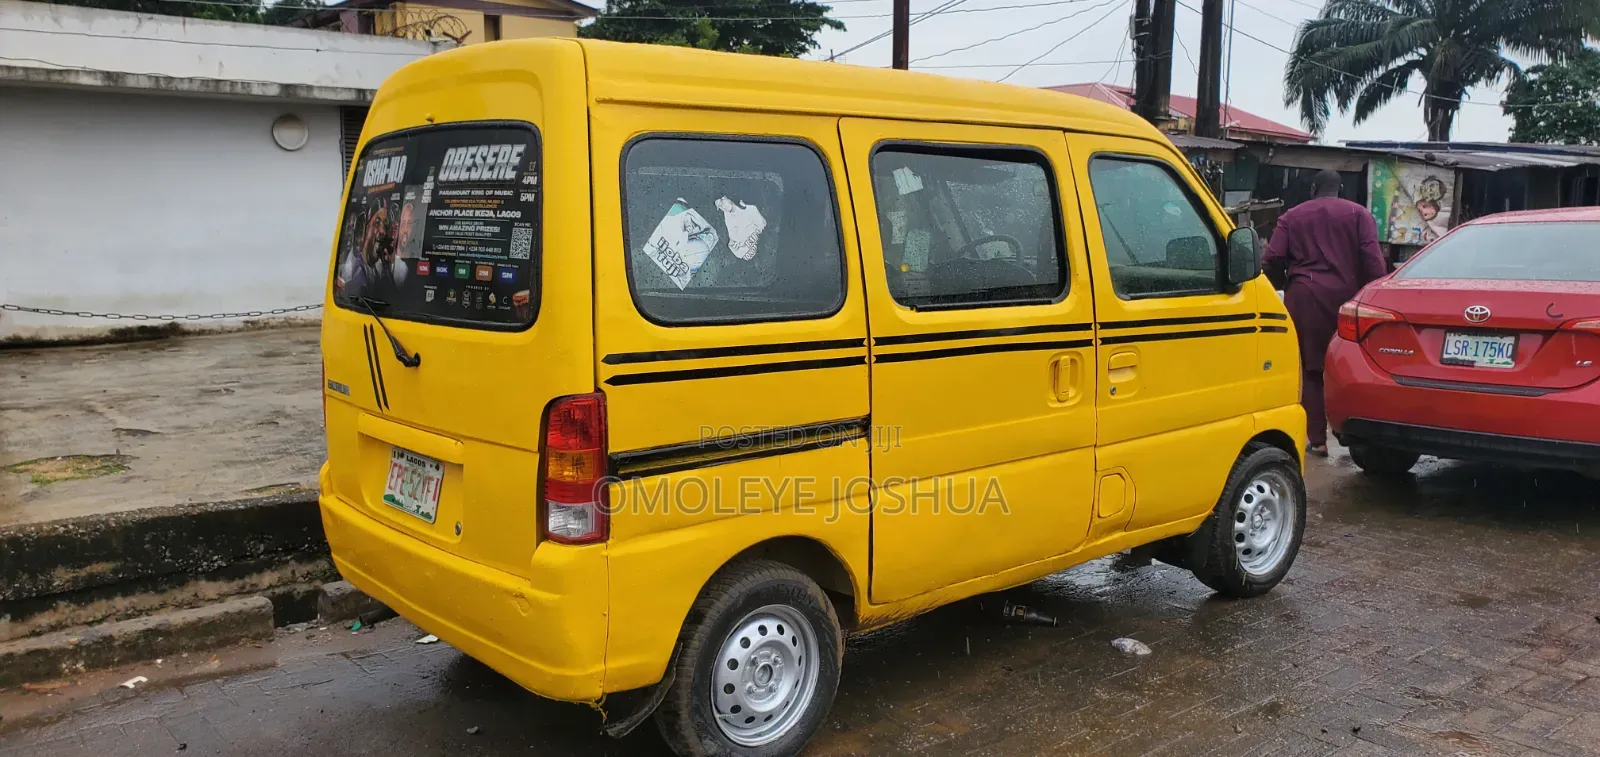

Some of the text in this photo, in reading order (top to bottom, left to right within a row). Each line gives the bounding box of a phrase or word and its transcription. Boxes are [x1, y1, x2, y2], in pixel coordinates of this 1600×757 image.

[437, 144, 526, 182] OBESERE
[522, 176, 537, 185] 4PM
[520, 192, 535, 202] 5PM
[429, 209, 522, 218] ANCHOR PLACE IKEJA, LAGOS
[449, 224, 475, 232] AMAZING
[476, 225, 501, 233] PRIZES!
[406, 455, 426, 468] LAGOS
